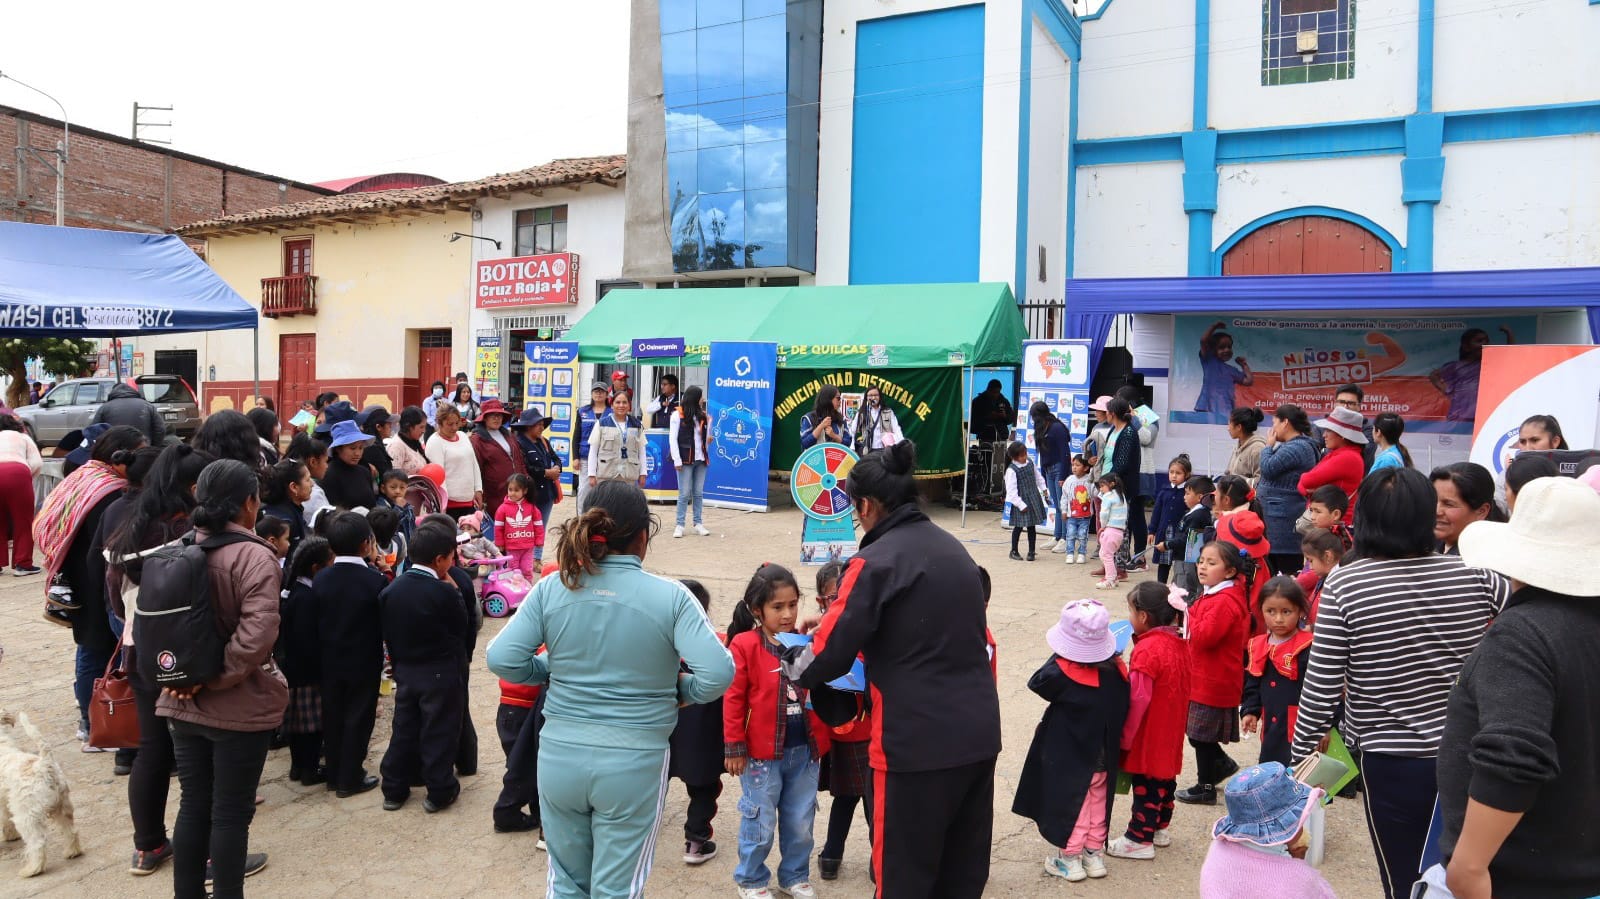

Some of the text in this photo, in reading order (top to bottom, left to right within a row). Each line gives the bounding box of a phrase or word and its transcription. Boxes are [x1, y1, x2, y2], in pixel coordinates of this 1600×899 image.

[480, 260, 550, 282] BOTICA
[480, 281, 550, 297] Cruz Roja
[1233, 319, 1266, 327] Cuando
[1279, 321, 1319, 329] ganamos
[791, 345, 808, 355] DE
[811, 344, 867, 355] QUILCAS
[1283, 347, 1366, 366] NIÑOS DE
[1287, 364, 1367, 385] HIERRO
[715, 377, 770, 390] Osinergmin
[774, 371, 932, 421] MUNICIPAIDAD DISTRITAL DE
[1273, 392, 1390, 403] Para prevenir EMIA
[1255, 400, 1274, 408] dale
[1277, 401, 1322, 410] alientos
[1370, 403, 1409, 413] HIERRO
